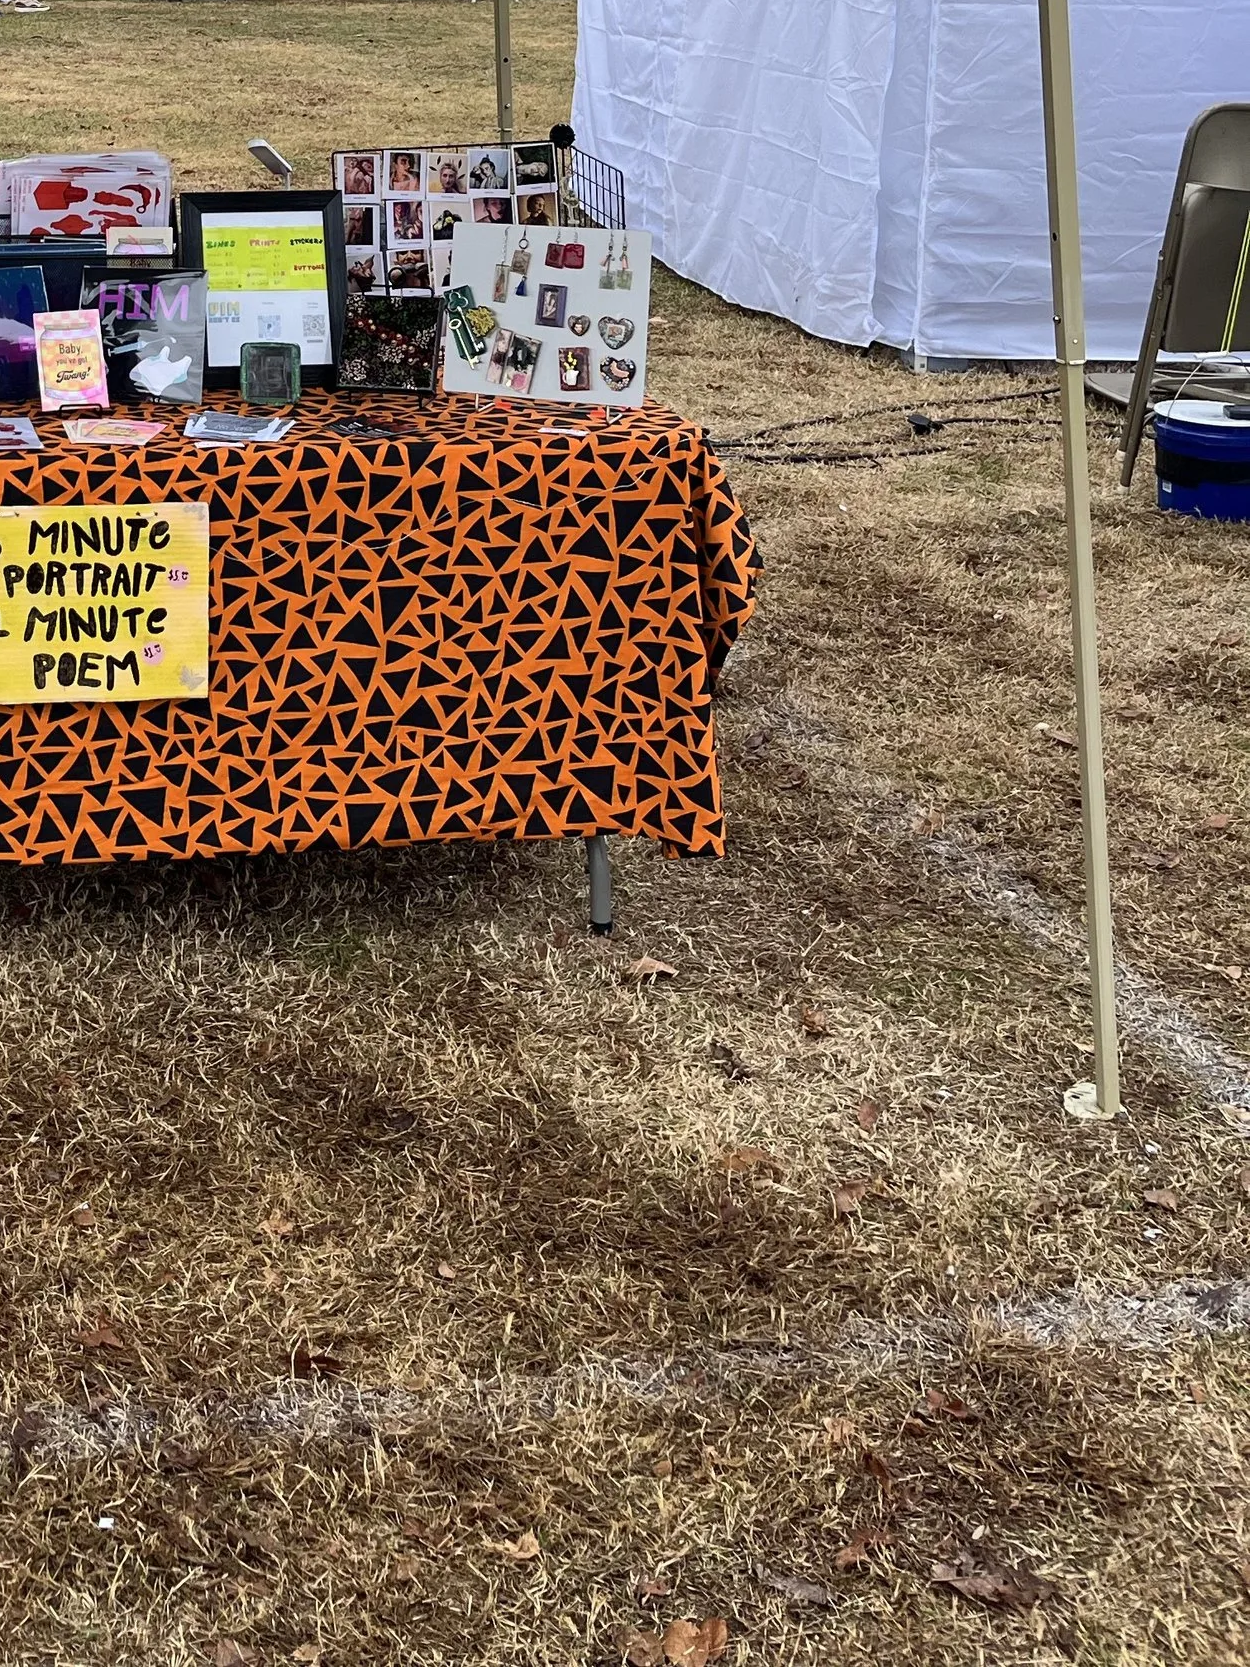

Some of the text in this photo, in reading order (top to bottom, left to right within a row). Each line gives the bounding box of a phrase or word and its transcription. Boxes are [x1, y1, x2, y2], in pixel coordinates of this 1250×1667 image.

[98, 284, 190, 322] HIM
[56, 366, 92, 383] Twang!
[3, 560, 166, 598] PORTRAIT
[33, 650, 140, 691] POEM
